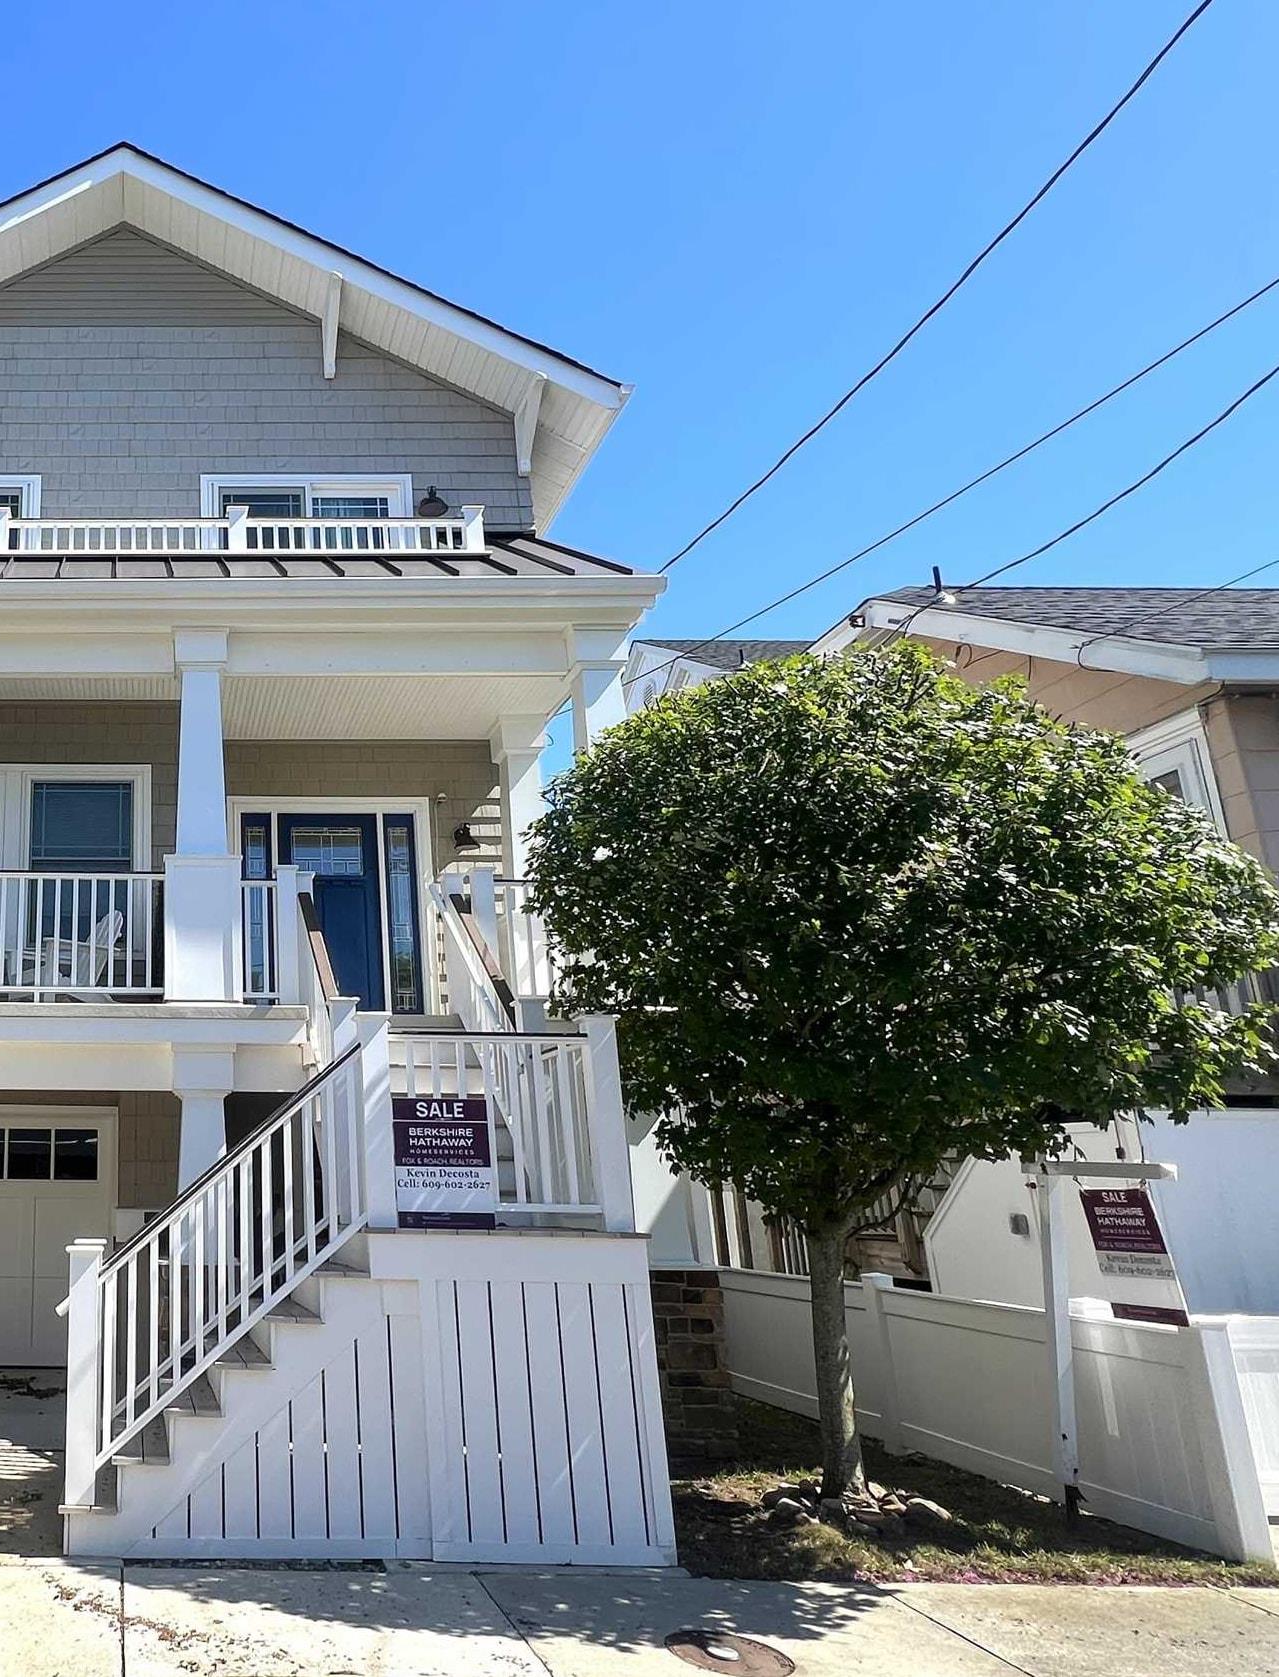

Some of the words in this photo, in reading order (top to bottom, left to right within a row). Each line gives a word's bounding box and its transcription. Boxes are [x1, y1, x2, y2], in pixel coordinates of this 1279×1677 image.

[415, 1102, 464, 1118] SALE
[408, 1127, 474, 1137] BERKSHIRE
[409, 1138, 474, 1147] HATHAWAY
[406, 1168, 437, 1178] Kevin
[439, 1169, 480, 1179] Decosta
[397, 1179, 420, 1189] Cell:
[421, 1179, 491, 1190] 609-602-2627
[1101, 1191, 1129, 1203] SALE
[1093, 1206, 1145, 1216] BERKSHIRE
[1096, 1217, 1147, 1227] HATHAWAY
